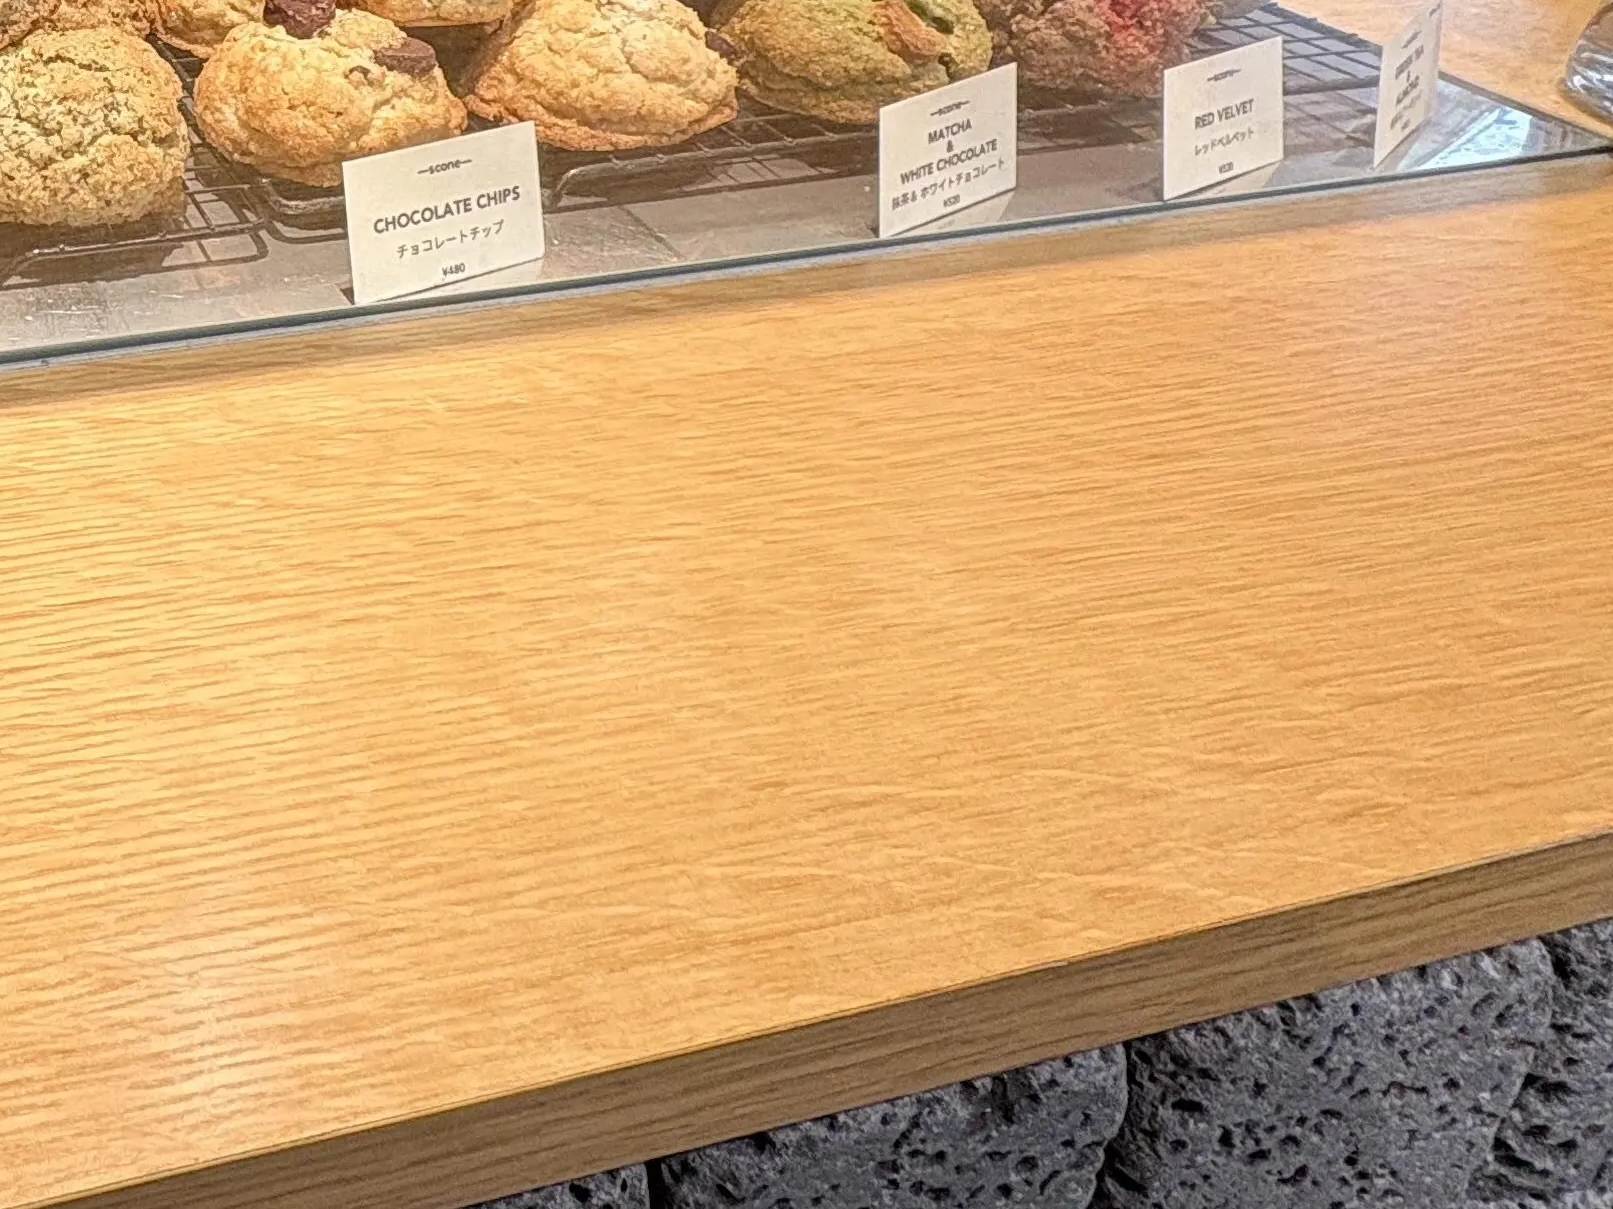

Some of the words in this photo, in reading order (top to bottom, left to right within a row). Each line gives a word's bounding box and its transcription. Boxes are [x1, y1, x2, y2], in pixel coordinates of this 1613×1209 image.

[928, 118, 972, 144] MATCHA
[1195, 112, 1215, 130] RED
[1217, 99, 1254, 122] VELVET
[900, 162, 934, 185] WHITE
[936, 138, 998, 171] CHOCOLATE
[373, 197, 472, 234] CHOCOLATE
[476, 186, 521, 209] CHIPS
[396, 219, 505, 259] チョコレートチップ
